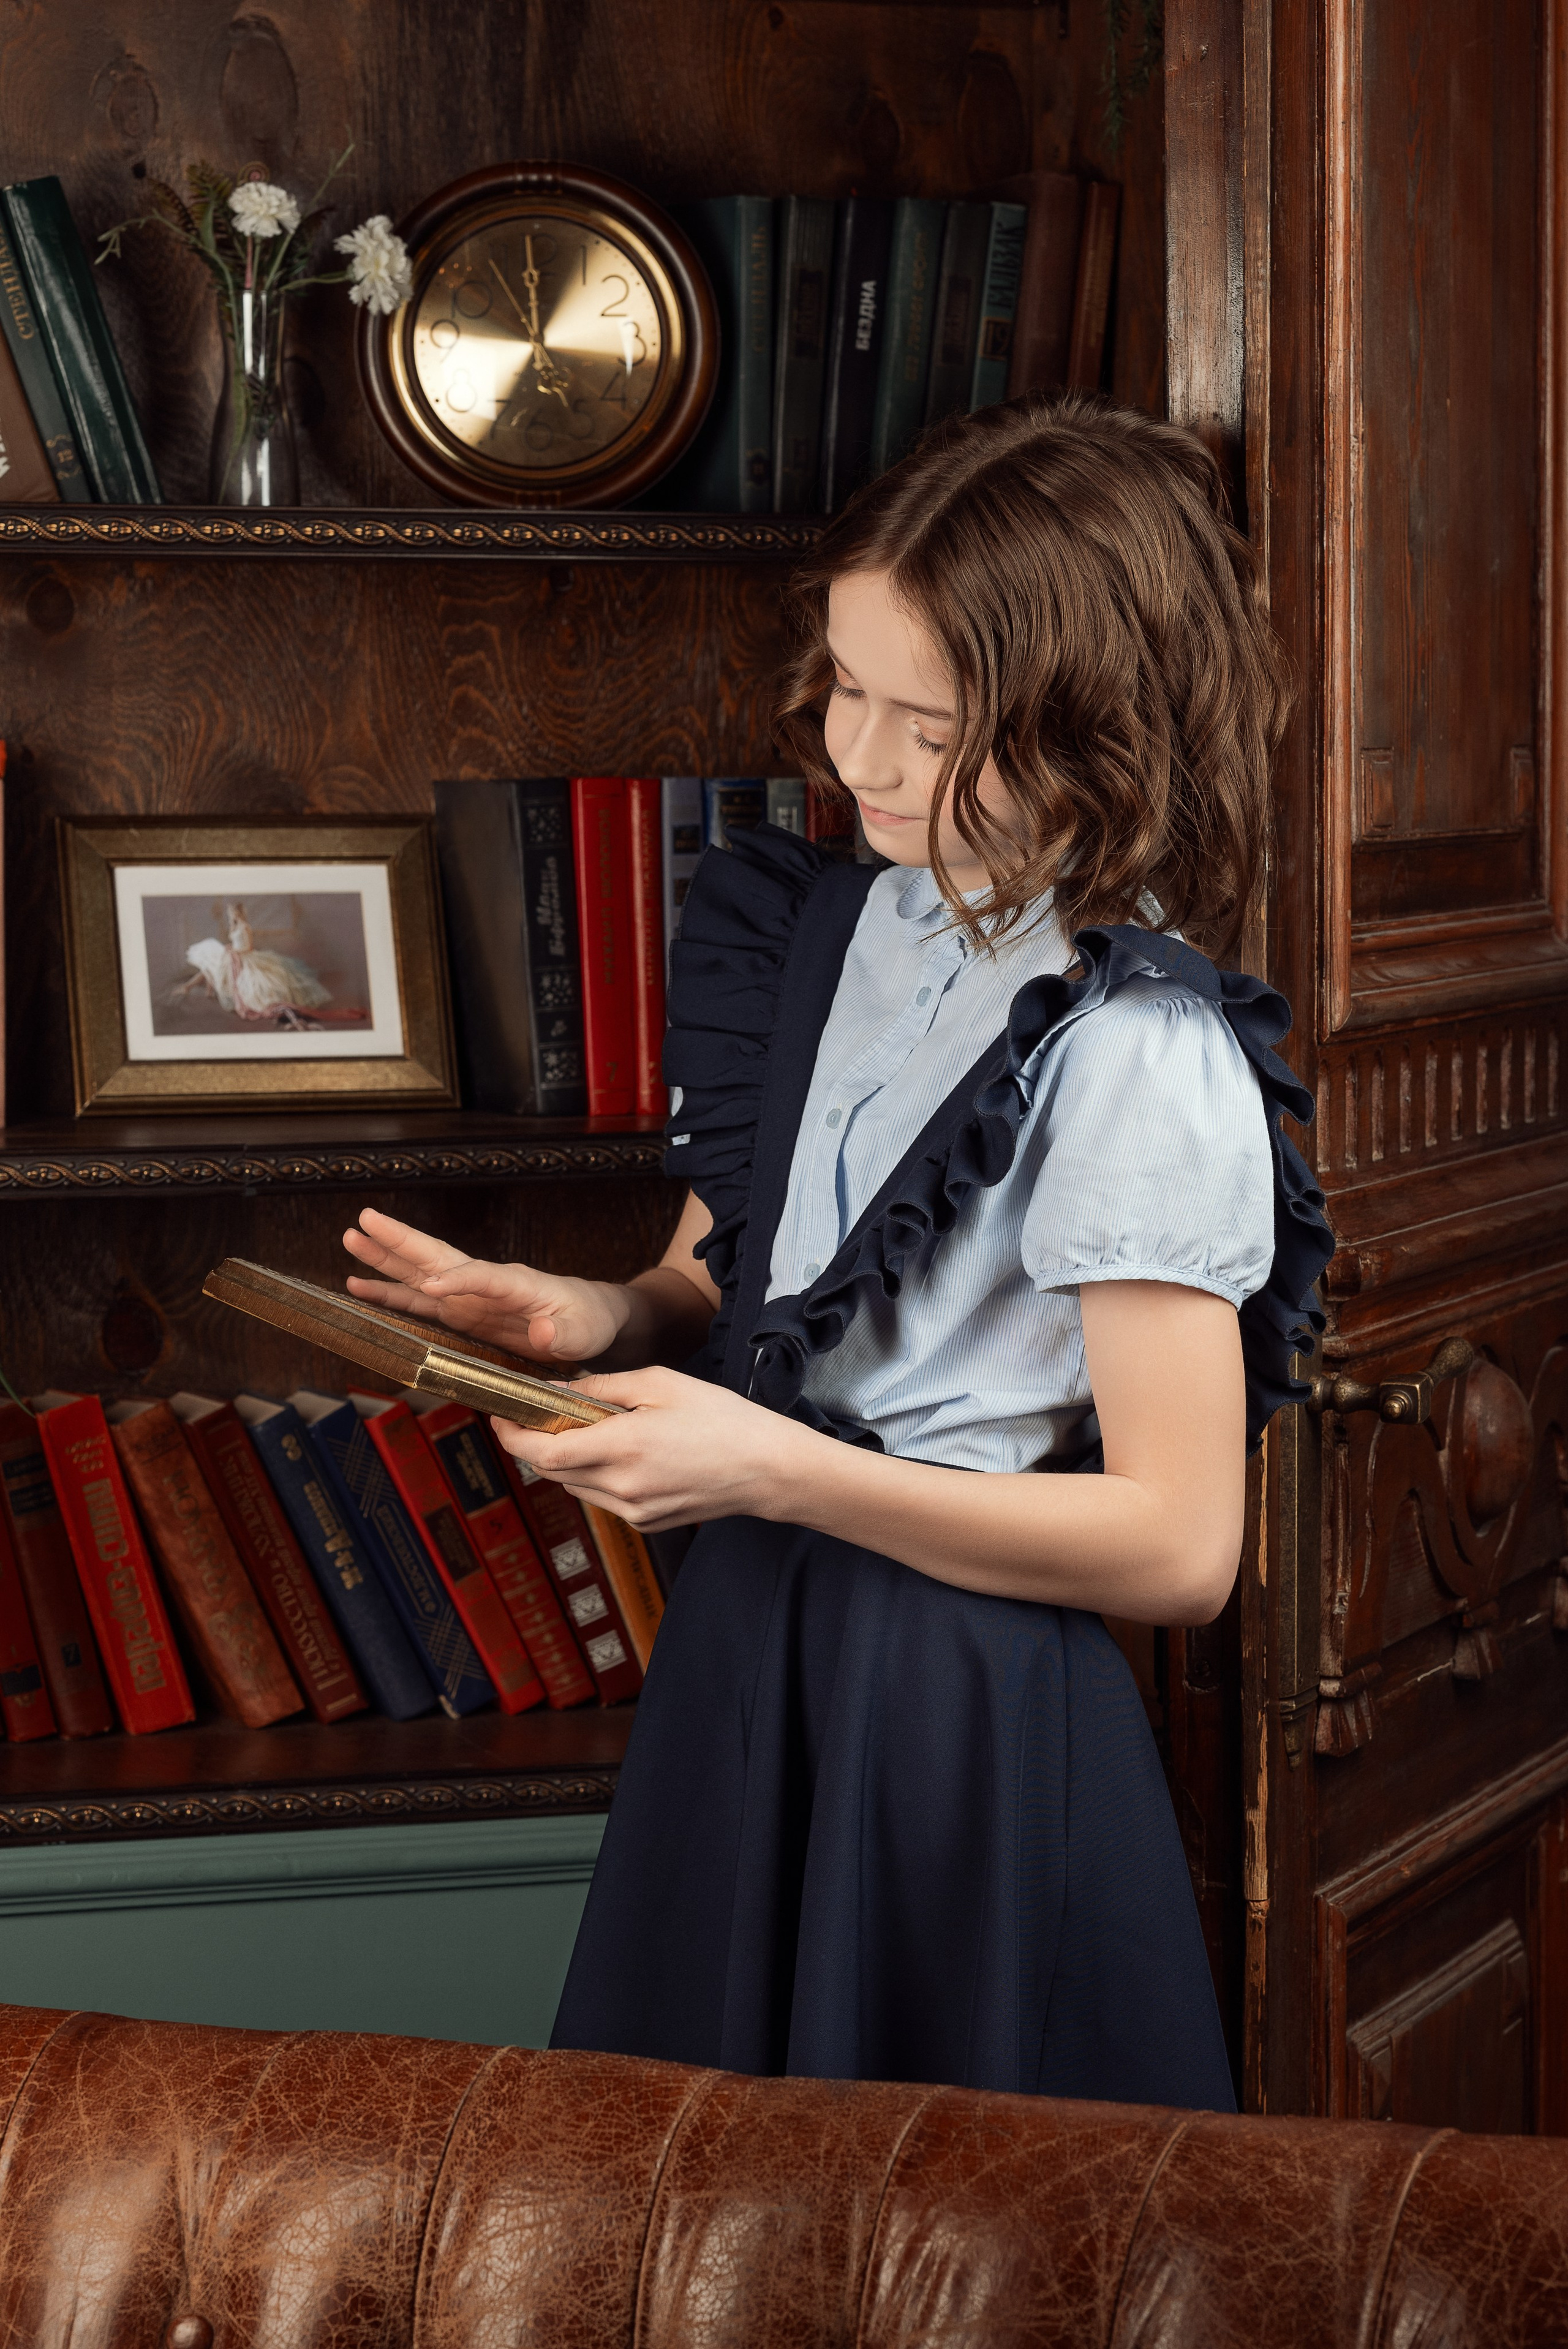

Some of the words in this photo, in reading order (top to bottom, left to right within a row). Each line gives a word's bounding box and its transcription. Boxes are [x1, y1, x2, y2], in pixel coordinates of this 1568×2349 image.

[451, 279, 493, 319] 10
[598, 273, 630, 318] 2
[855, 279, 877, 350] БЕЗДНА
[430, 319, 461, 363] 9
[617, 320, 647, 368] 3
[445, 368, 477, 413] 8
[600, 369, 628, 410] 4
[598, 807, 613, 899] ШОЛОХОВ
[601, 907, 616, 983] МИХАИЛ
[222, 1454, 271, 1558] ХУДОЖНИК
[271, 1572, 330, 1678] ИСКУССТВО
